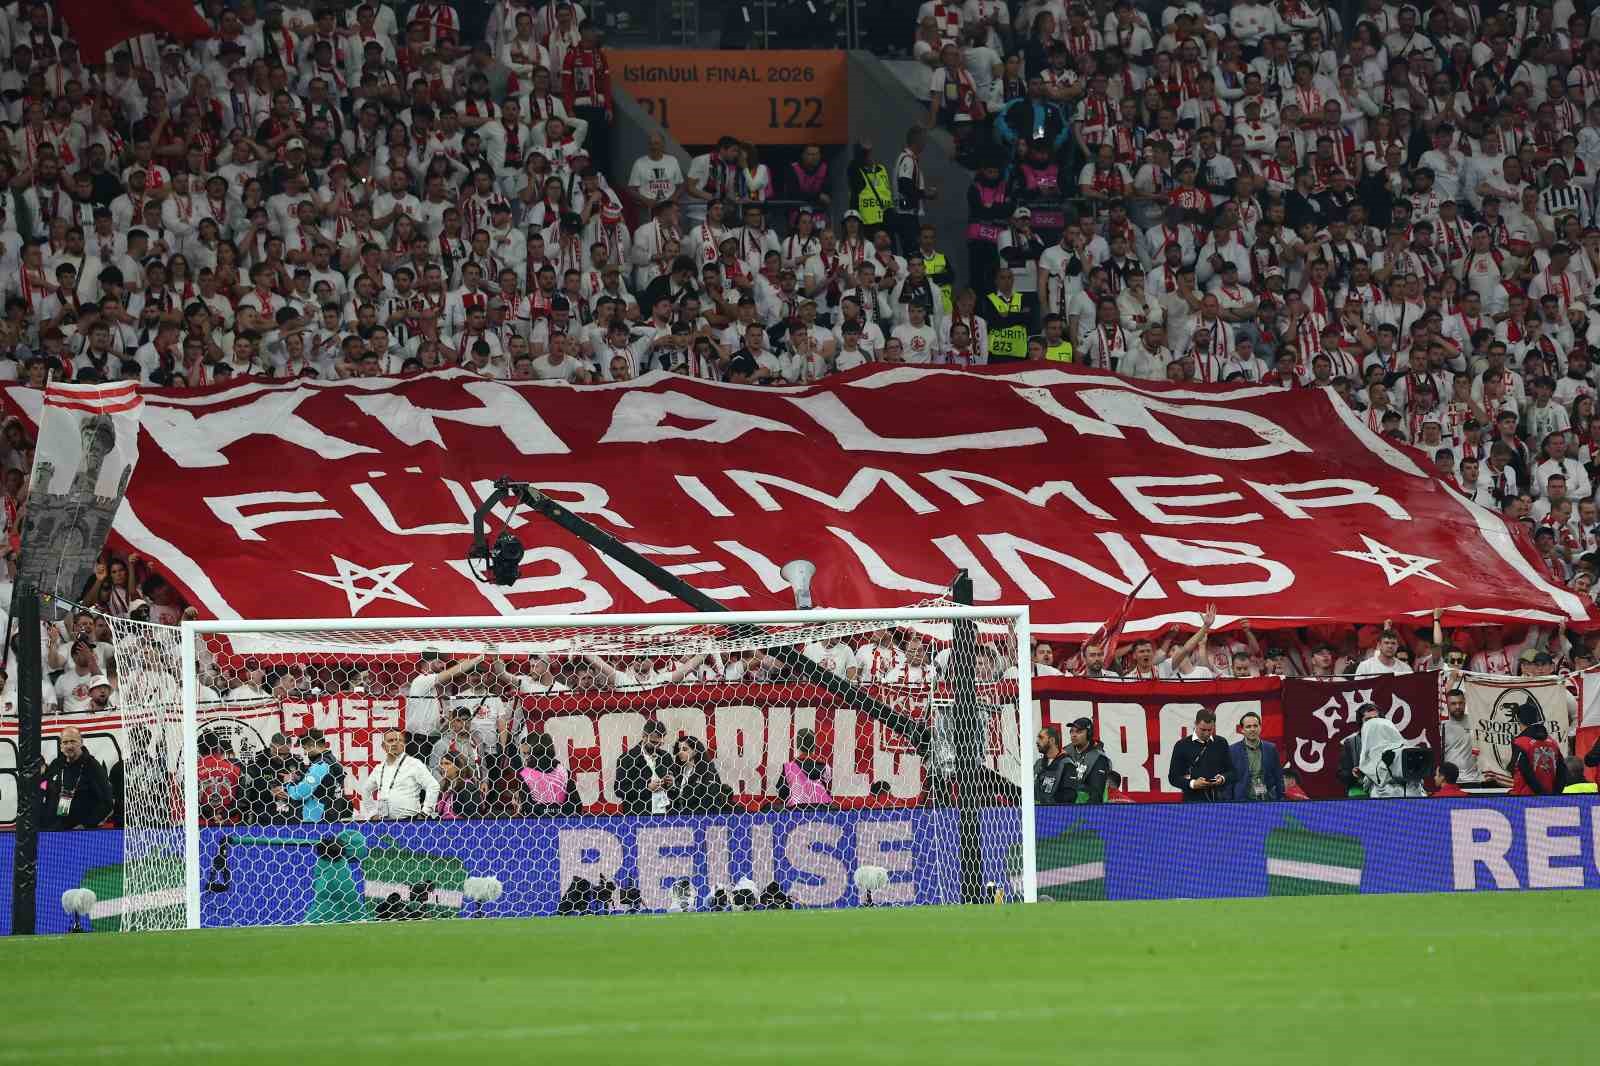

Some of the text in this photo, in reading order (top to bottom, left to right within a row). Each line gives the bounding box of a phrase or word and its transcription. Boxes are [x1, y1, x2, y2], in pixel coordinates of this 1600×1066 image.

[705, 66, 760, 82] FINAL
[767, 66, 815, 82] 2026
[768, 97, 824, 128] 122
[993, 341, 1013, 352] 273
[138, 382, 1313, 468] KHALID
[203, 466, 1412, 541] FÜR IMMER
[444, 526, 1295, 616] BEI UNS
[559, 820, 914, 908] REUSE
[1450, 806, 1600, 890] RE
